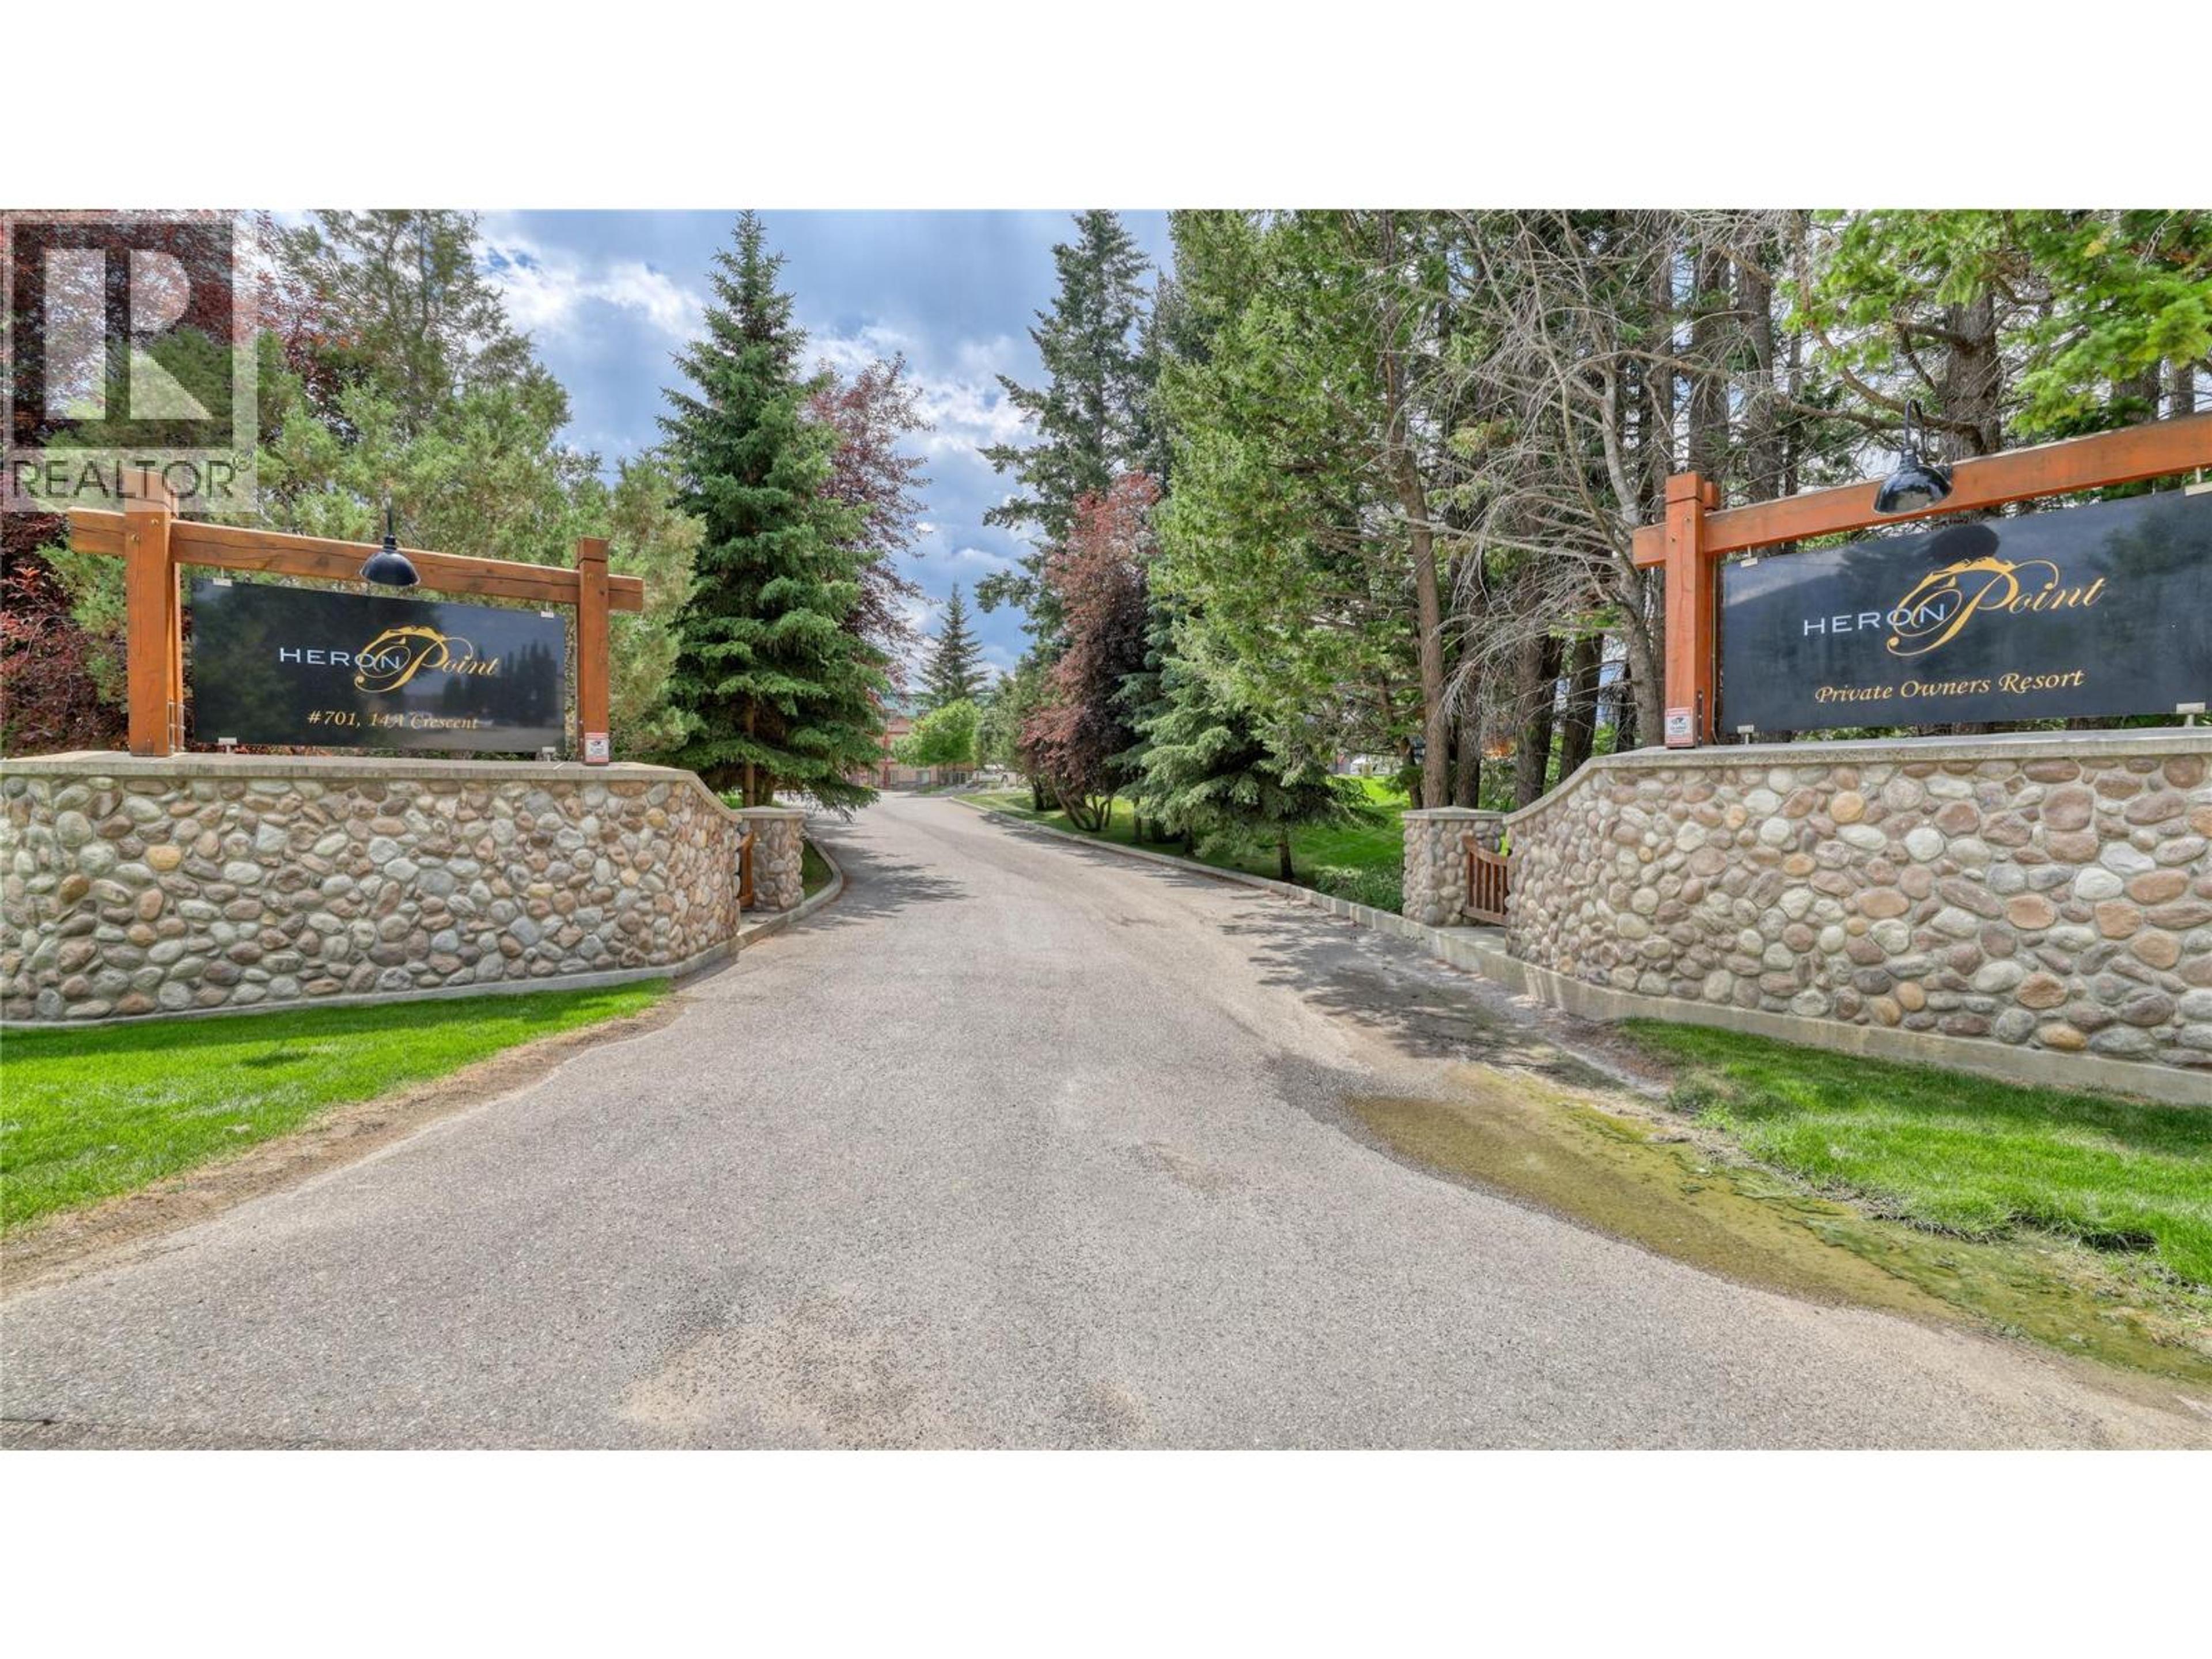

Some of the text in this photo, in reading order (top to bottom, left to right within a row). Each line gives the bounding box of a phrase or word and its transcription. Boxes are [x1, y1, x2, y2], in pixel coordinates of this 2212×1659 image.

[1803, 556, 2106, 657] HERON Point
[280, 626, 500, 693] HERON Point
[1815, 669, 2086, 704] Private Owners Resort
[306, 709, 361, 728] #701,
[410, 711, 481, 730] Crescent
